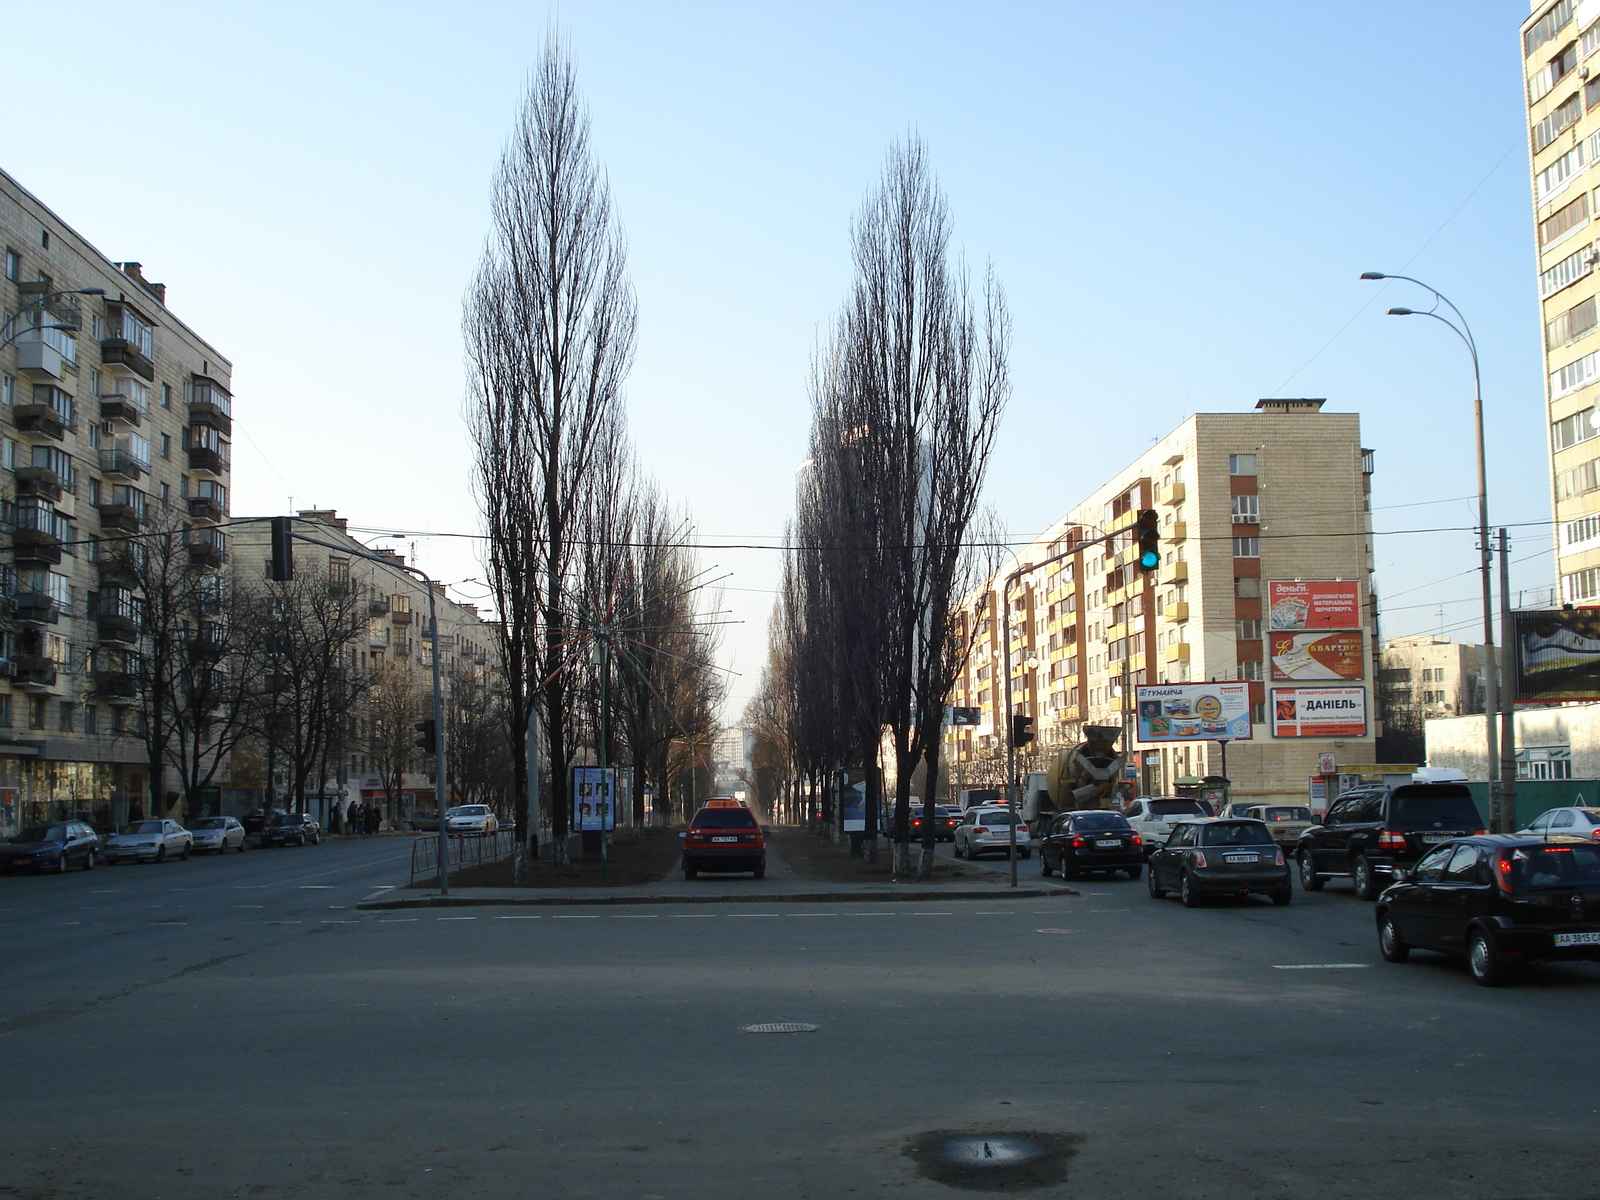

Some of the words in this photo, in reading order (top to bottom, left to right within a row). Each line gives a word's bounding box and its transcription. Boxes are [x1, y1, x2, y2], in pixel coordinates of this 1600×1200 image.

[1310, 644, 1361, 652] КВАРТИРУ
[1147, 688, 1183, 697] ТУНАЙЧА
[1560, 935, 1571, 943] AA
[1572, 934, 1591, 943] 3815
